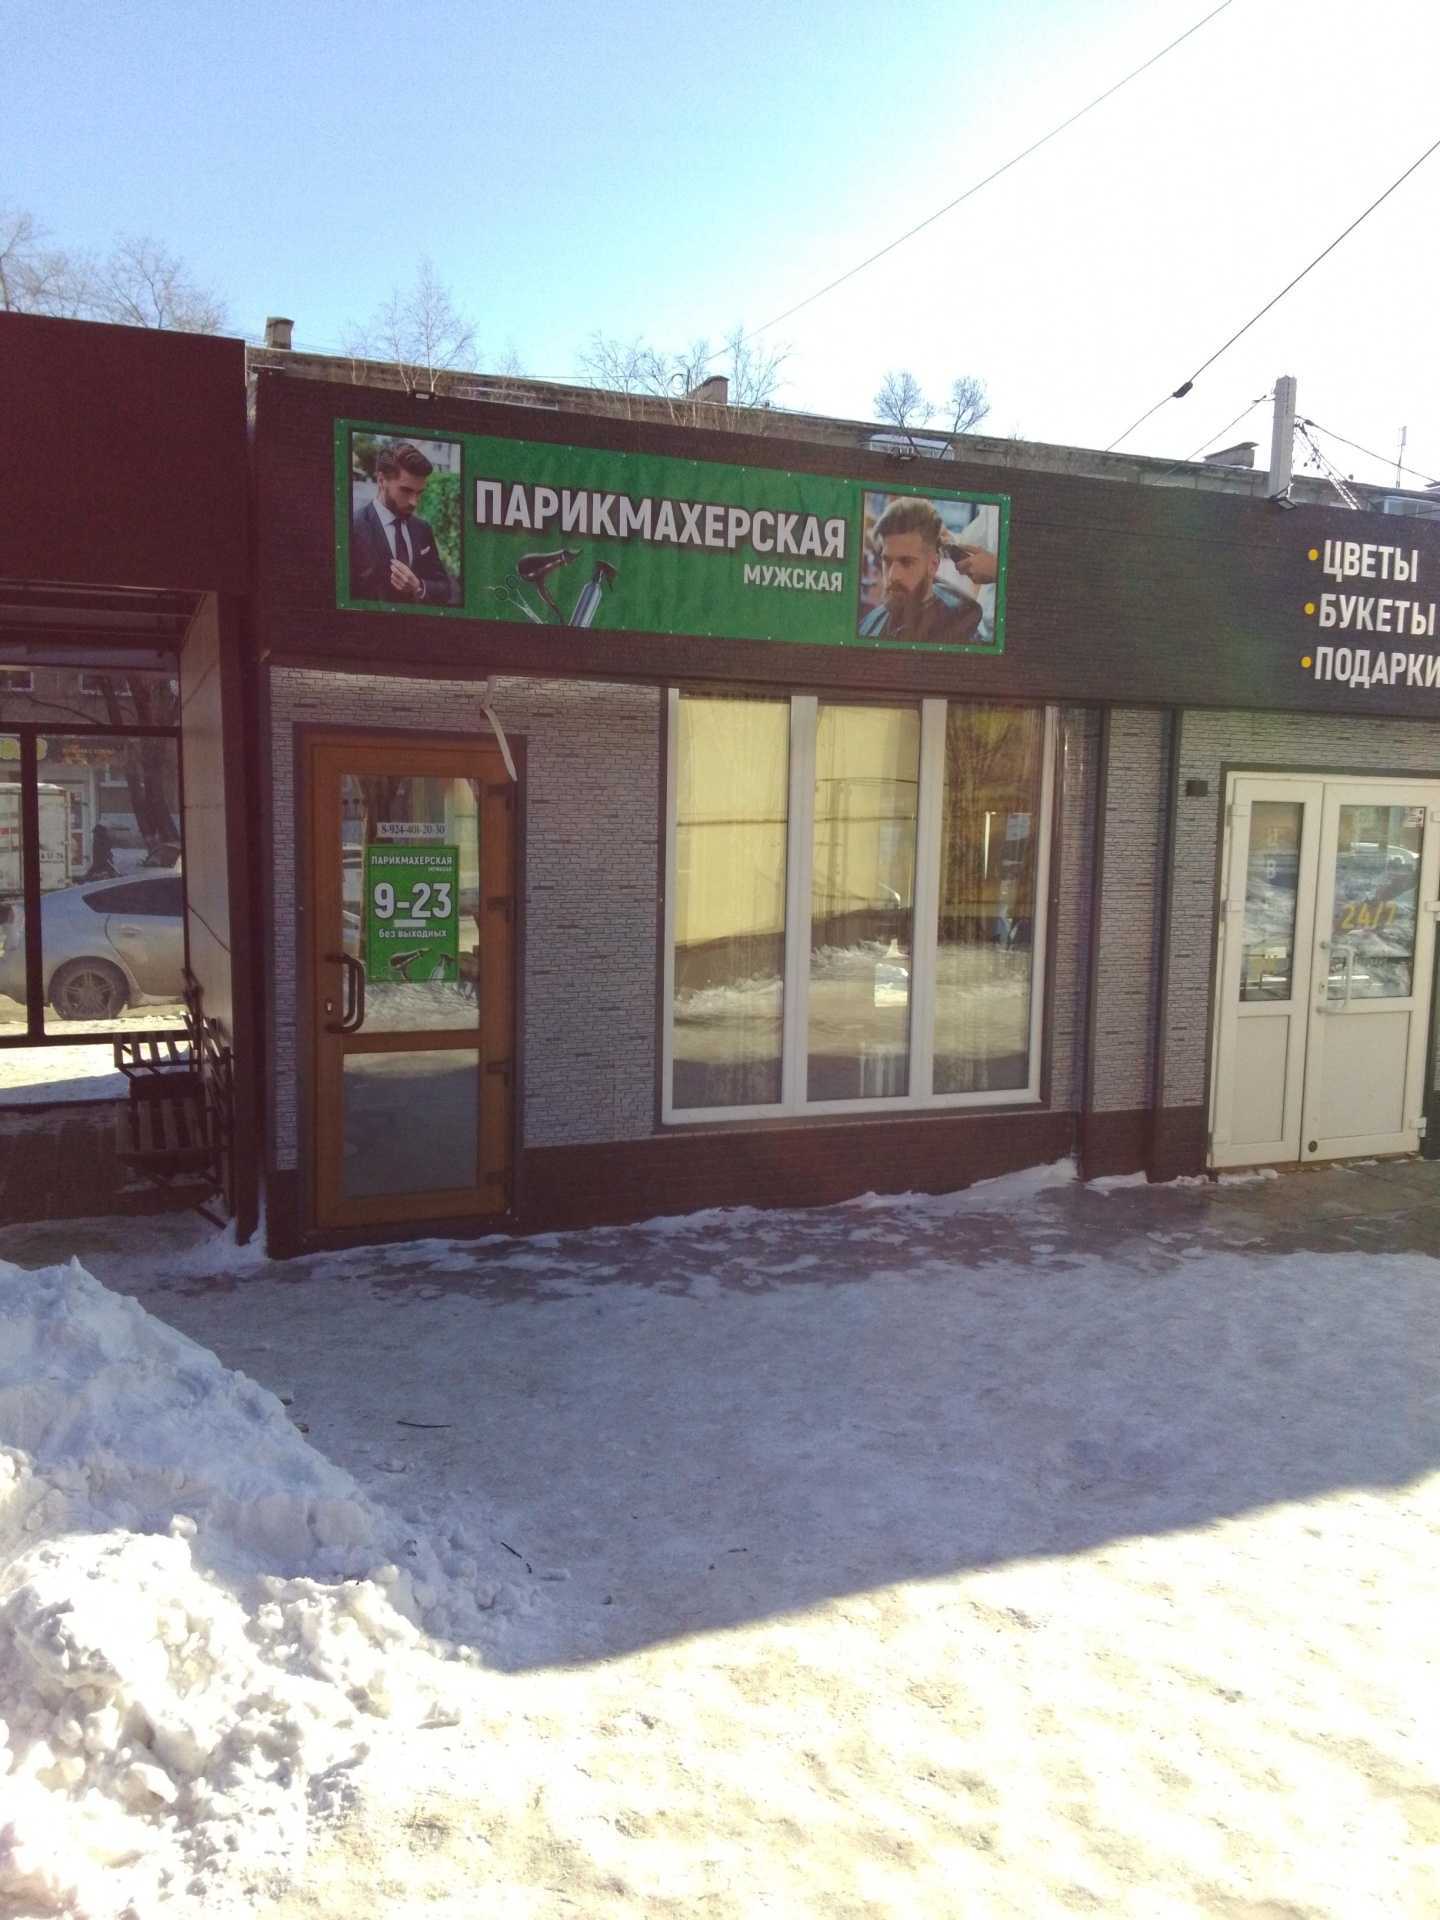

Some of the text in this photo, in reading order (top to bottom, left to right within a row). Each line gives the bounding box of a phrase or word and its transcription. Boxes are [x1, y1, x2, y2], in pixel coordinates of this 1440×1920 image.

[476, 479, 845, 559] ПАРИКМАХЕРСКАЯ
[743, 563, 843, 593] МУЖСКАЯ
[1322, 539, 1419, 583] ЦВЕТЫ
[1318, 593, 1436, 636] БУКЕТЫ
[1314, 646, 1440, 689] ПОДАРКИ
[371, 856, 452, 865] ПАРИКМАХЕРСКАЯ
[374, 882, 452, 919] 9-23
[1341, 900, 1398, 929] 24/7
[379, 928, 447, 938] без выходных
